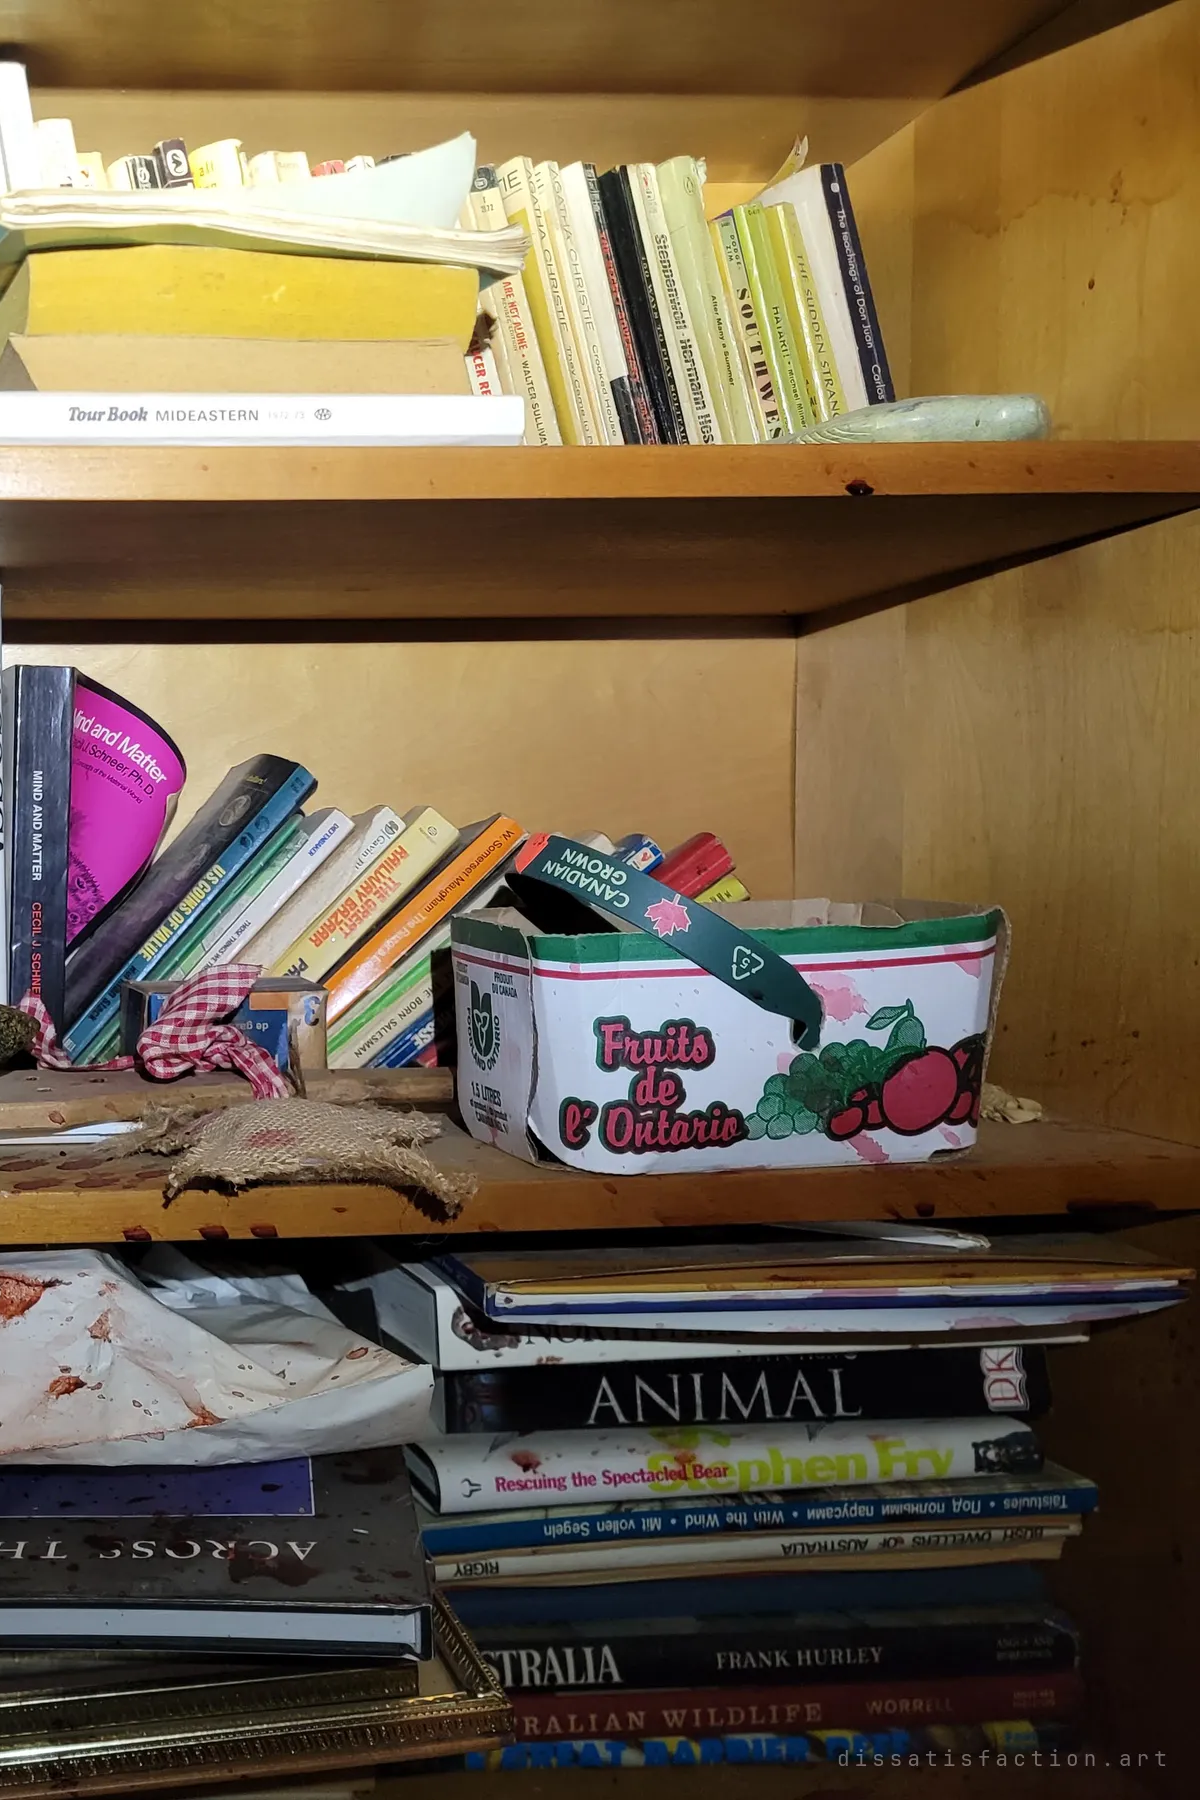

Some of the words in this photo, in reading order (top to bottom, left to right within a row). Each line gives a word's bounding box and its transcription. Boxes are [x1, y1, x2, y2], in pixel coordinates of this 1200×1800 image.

[543, 249, 569, 333] CHRISTIE
[569, 249, 595, 331] CHRISTIE
[806, 288, 825, 353] SUDDEN
[521, 360, 537, 400] WALTER
[69, 407, 105, 421] Tour
[108, 407, 148, 422] Book
[156, 409, 259, 422] MIDEASTERN
[89, 745, 129, 776] Schneer,
[91, 724, 122, 746] and
[117, 736, 167, 784] Matter
[32, 770, 42, 802] MIND
[32, 807, 42, 834] AND
[32, 837, 43, 881] MATTER
[355, 844, 410, 901] RAILWAY
[463, 838, 503, 877] Somerset
[560, 847, 629, 884] GROWN
[207, 864, 226, 887] U.S.
[541, 860, 630, 909] CANADIAN
[184, 880, 211, 914] COINS
[424, 874, 466, 914] Maugham
[31, 901, 41, 938] CECIL
[141, 921, 174, 962] VALUE
[399, 996, 424, 1020] BORN
[354, 1015, 399, 1059] SALESMAN
[467, 1008, 486, 1071] FOODLAND
[487, 1015, 500, 1071] ONTARIO
[595, 1015, 716, 1071] Fruits
[471, 1082, 480, 1099] 1.5
[482, 1085, 501, 1107] LITRES
[627, 1066, 687, 1109] de
[600, 1098, 751, 1154] Ontario
[586, 1370, 863, 1424] ANIMAL
[987, 1348, 1020, 1404] DK
[878, 1440, 954, 1480] Fry
[495, 1472, 566, 1492] Rescuing
[571, 1470, 596, 1487] the
[602, 1464, 688, 1487] Spectacled
[693, 1463, 729, 1480] Bear
[636, 1515, 661, 1530] Mit
[685, 1512, 718, 1528] Wind
[726, 1511, 748, 1526] the
[754, 1509, 784, 1525] With
[807, 1504, 874, 1524] парусами
[882, 1501, 945, 1518] полными
[953, 1498, 981, 1515] Под
[544, 1520, 590, 1537] Segeln
[597, 1517, 634, 1534] vollen
[100, 1541, 317, 1561] ACROSS
[781, 1536, 869, 1555] AUSTRALIA
[452, 1561, 499, 1577] RIGBY
[716, 1648, 791, 1669] FRANK
[797, 1646, 883, 1667] HURLEY
[664, 1703, 823, 1728] WILDLIFE
